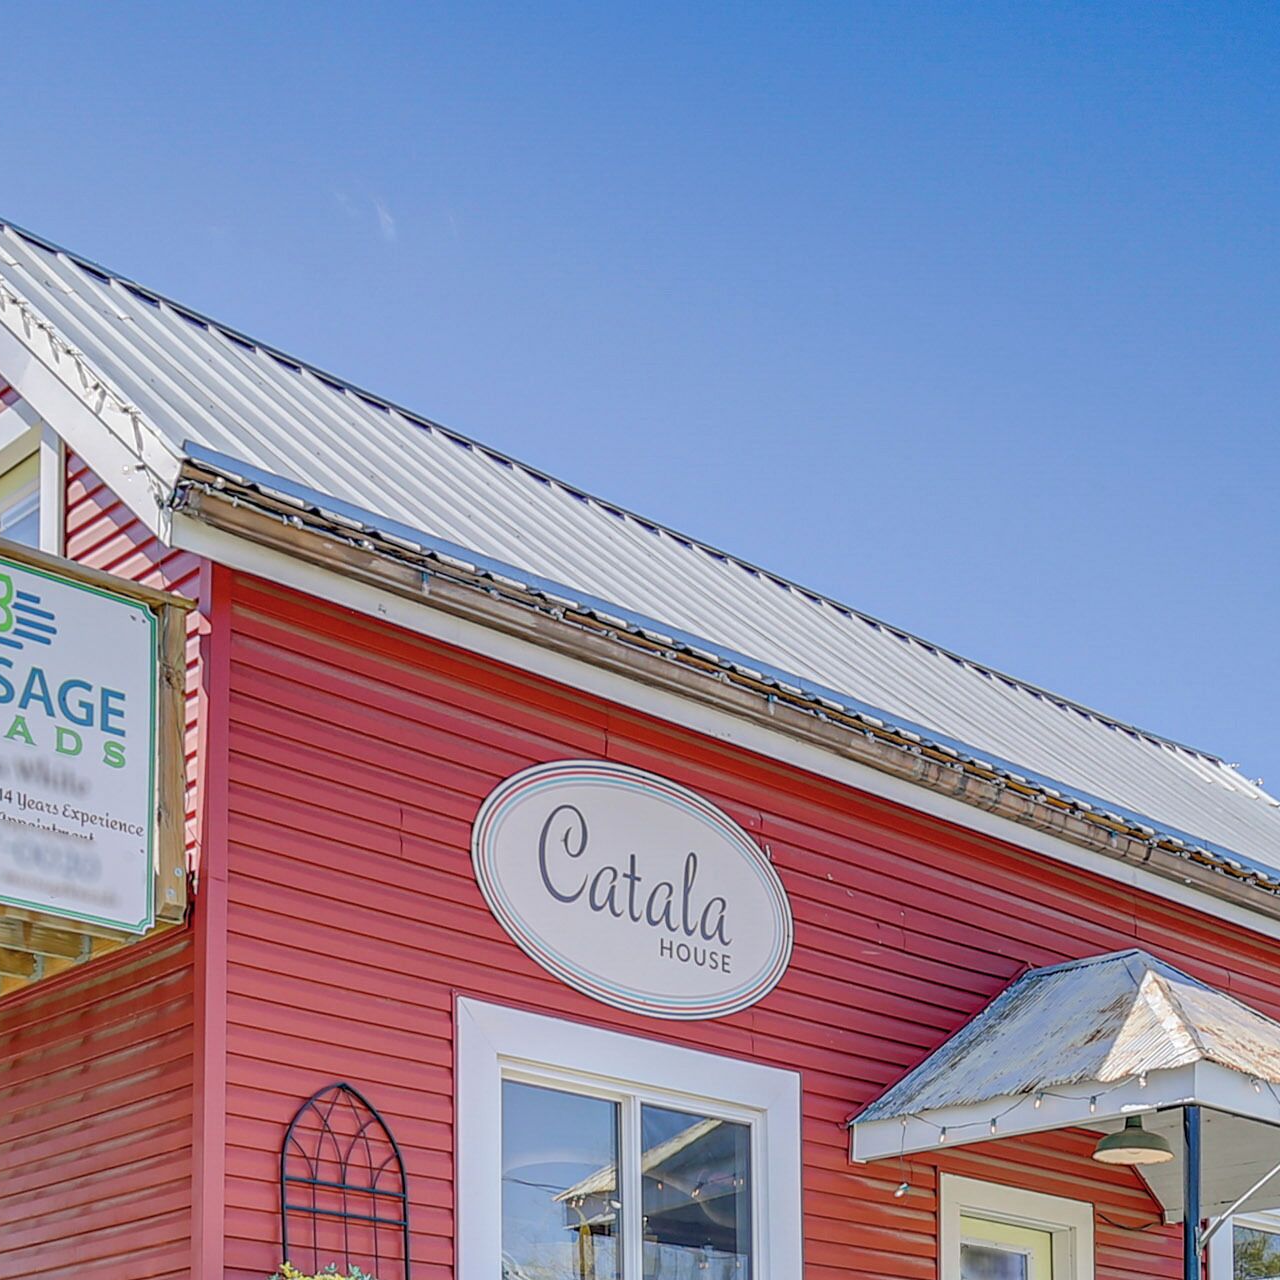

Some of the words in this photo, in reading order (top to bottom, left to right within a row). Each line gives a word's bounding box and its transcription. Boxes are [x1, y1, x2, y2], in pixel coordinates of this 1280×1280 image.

[18, 791, 59, 816] Years
[62, 803, 145, 837] Experience
[538, 804, 732, 946] Catala
[660, 938, 732, 974] HOUSE
